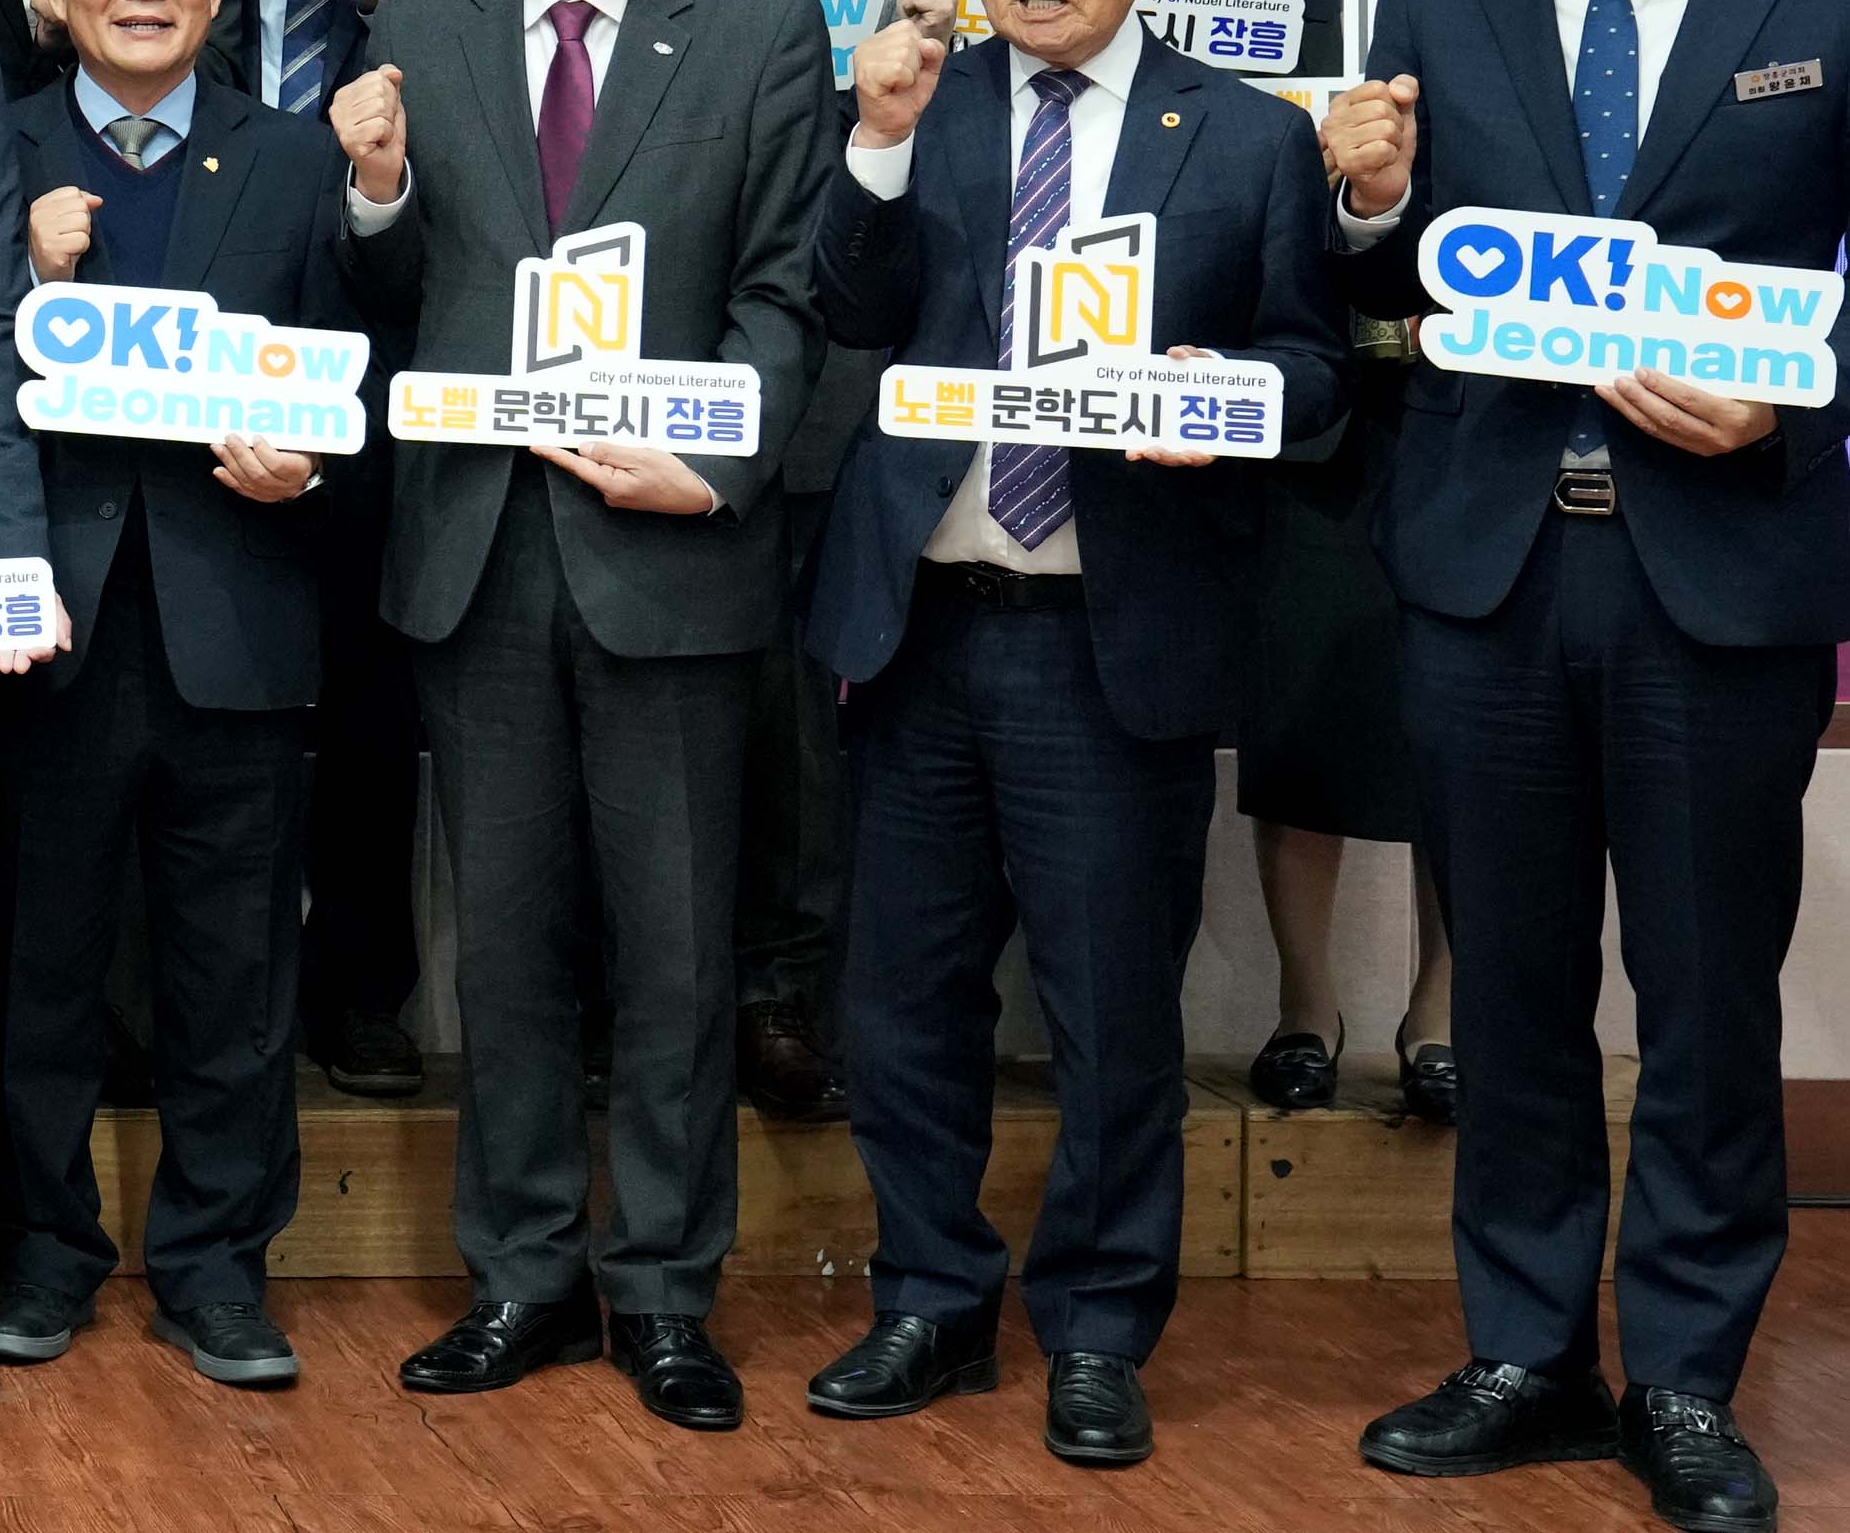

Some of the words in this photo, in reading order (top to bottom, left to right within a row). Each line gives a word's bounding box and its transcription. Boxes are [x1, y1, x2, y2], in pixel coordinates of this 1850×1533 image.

[1209, 16, 1287, 60] 장흥
[1437, 224, 1636, 312] OK!
[1644, 263, 1822, 327] Now
[32, 297, 199, 373] OK!
[208, 330, 349, 381] Now
[1440, 309, 1815, 389] Jeonnam
[36, 376, 346, 438] Jeonnam
[590, 371, 615, 385] City
[620, 373, 632, 384] of
[637, 374, 674, 385] Nobel
[679, 375, 745, 388] Literature
[1097, 367, 1124, 382] City
[1129, 369, 1144, 381] of
[1148, 370, 1189, 384] Nobel
[1193, 372, 1266, 387] Literature
[402, 385, 477, 429] 노벨
[493, 389, 649, 438] 문학도시
[666, 397, 744, 442] 장흥
[893, 379, 975, 427] 노벨
[992, 385, 1161, 437] 문학도시
[1180, 395, 1265, 443] 장흥
